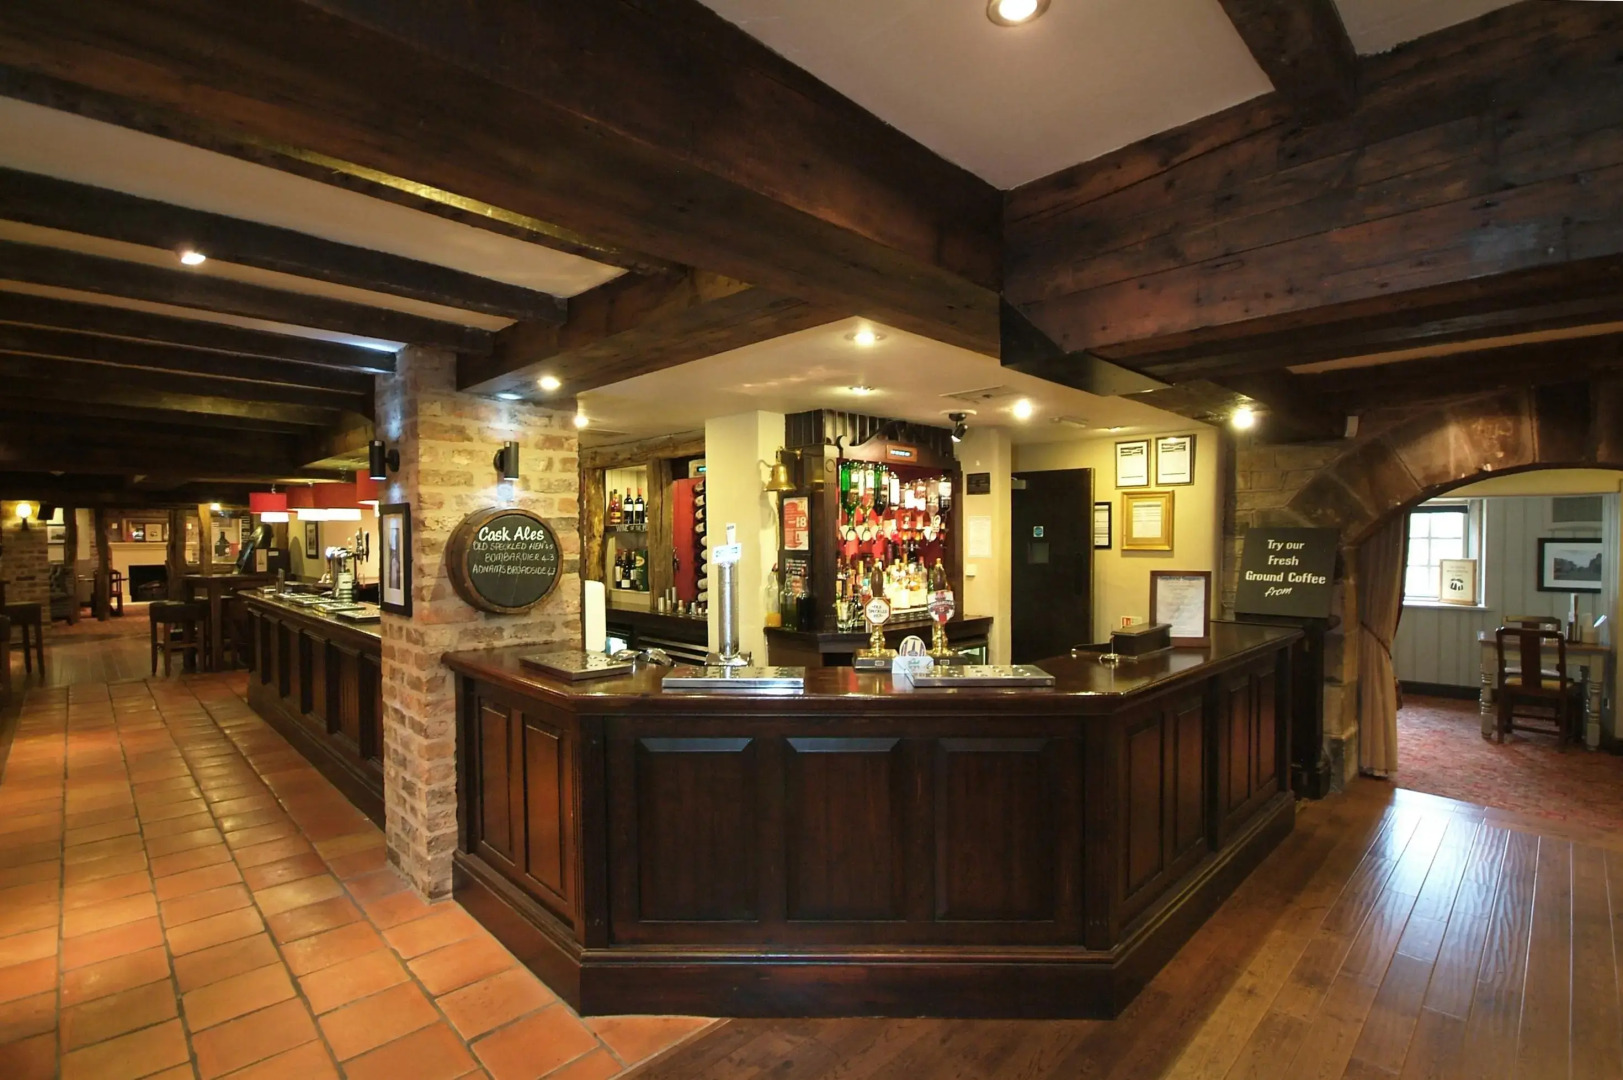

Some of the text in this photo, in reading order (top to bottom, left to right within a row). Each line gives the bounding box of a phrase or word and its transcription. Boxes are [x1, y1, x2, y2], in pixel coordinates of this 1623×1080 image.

[478, 526, 544, 541] Cask Ales
[473, 541, 488, 551] OLD
[490, 541, 527, 551] SPECKLED
[529, 541, 544, 550] HEN
[1268, 540, 1284, 551] Try
[485, 552, 539, 562] BOMBARDIER
[1268, 555, 1298, 566] Fresh
[1245, 570, 1326, 584] Ground Coffee
[1264, 586, 1292, 598] from
